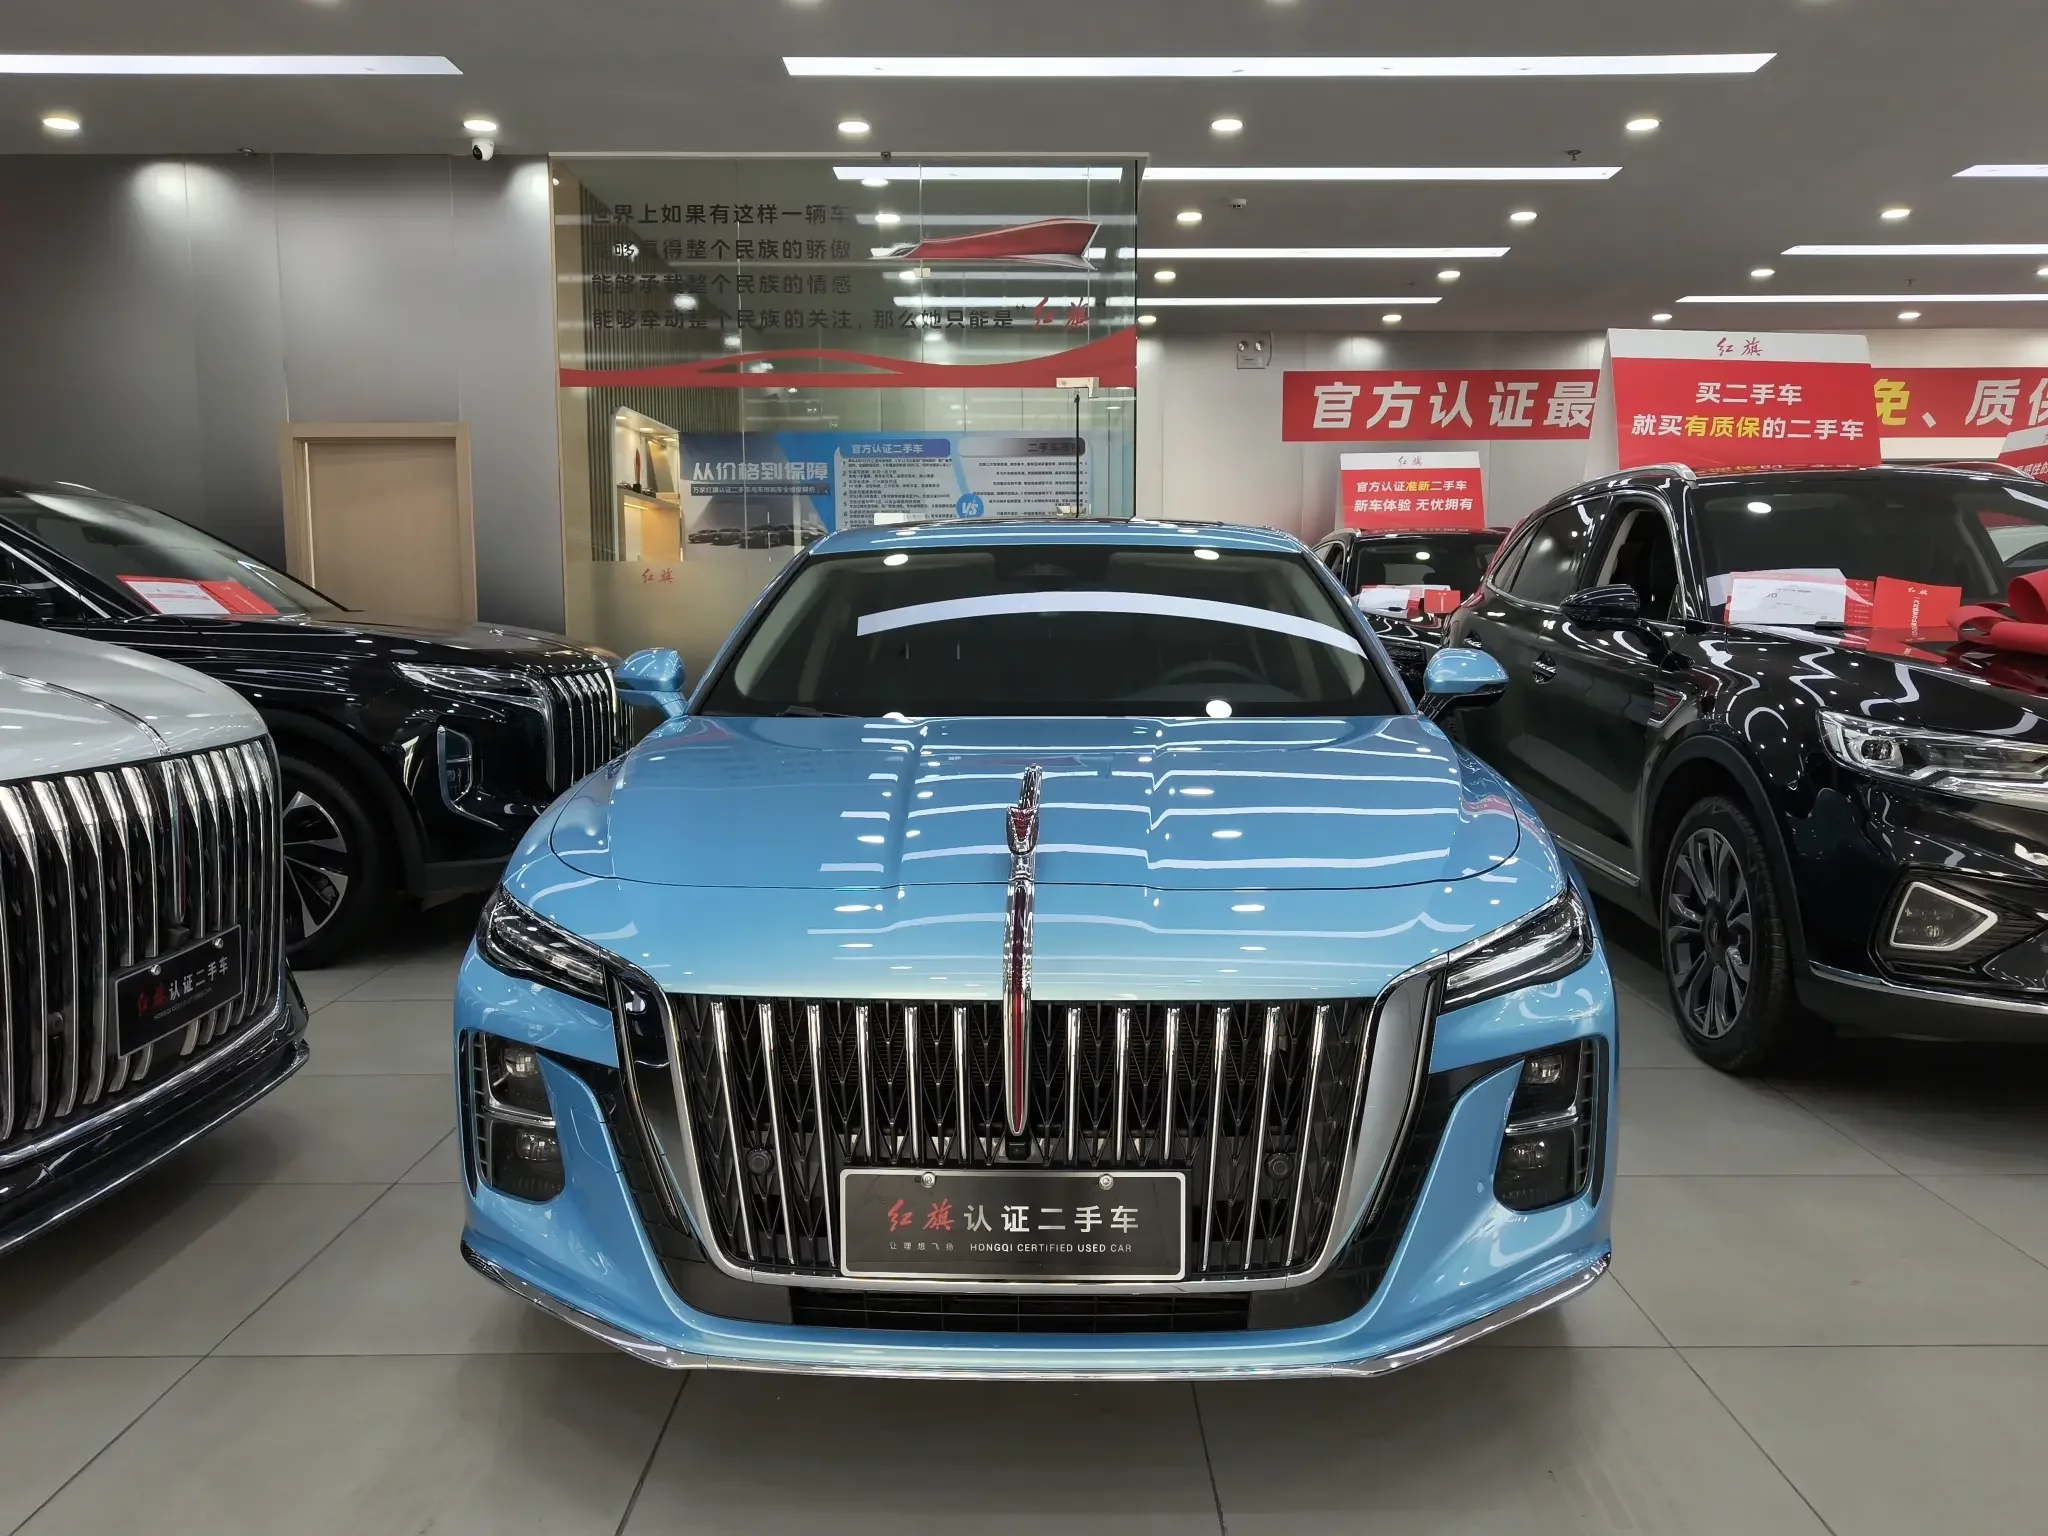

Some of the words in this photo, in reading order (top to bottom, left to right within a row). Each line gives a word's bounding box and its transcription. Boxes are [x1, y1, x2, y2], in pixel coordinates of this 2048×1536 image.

[592, 203, 849, 225] 世界上如果有这样一辆车
[592, 239, 850, 260] 够得整个民族的骄傲
[1716, 337, 1762, 356] 红旗
[1696, 382, 1802, 405] 买二手车
[1312, 380, 1596, 429] 官方认证最
[1631, 413, 1864, 441] 就买有质保的二手车
[852, 444, 923, 454] 官方认证二手车
[692, 461, 829, 481] 从价格到保障
[1357, 480, 1467, 493] 官方认证准新二手车
[962, 502, 978, 515] VS
[1353, 499, 1411, 512] 新车体验
[1416, 498, 1473, 511] 无忧拥有
[970, 1243, 1013, 1253] HONGQI
[1017, 1243, 1073, 1253] CERTIFIED
[1077, 1243, 1106, 1253] USED
[1110, 1243, 1132, 1253] CAR
